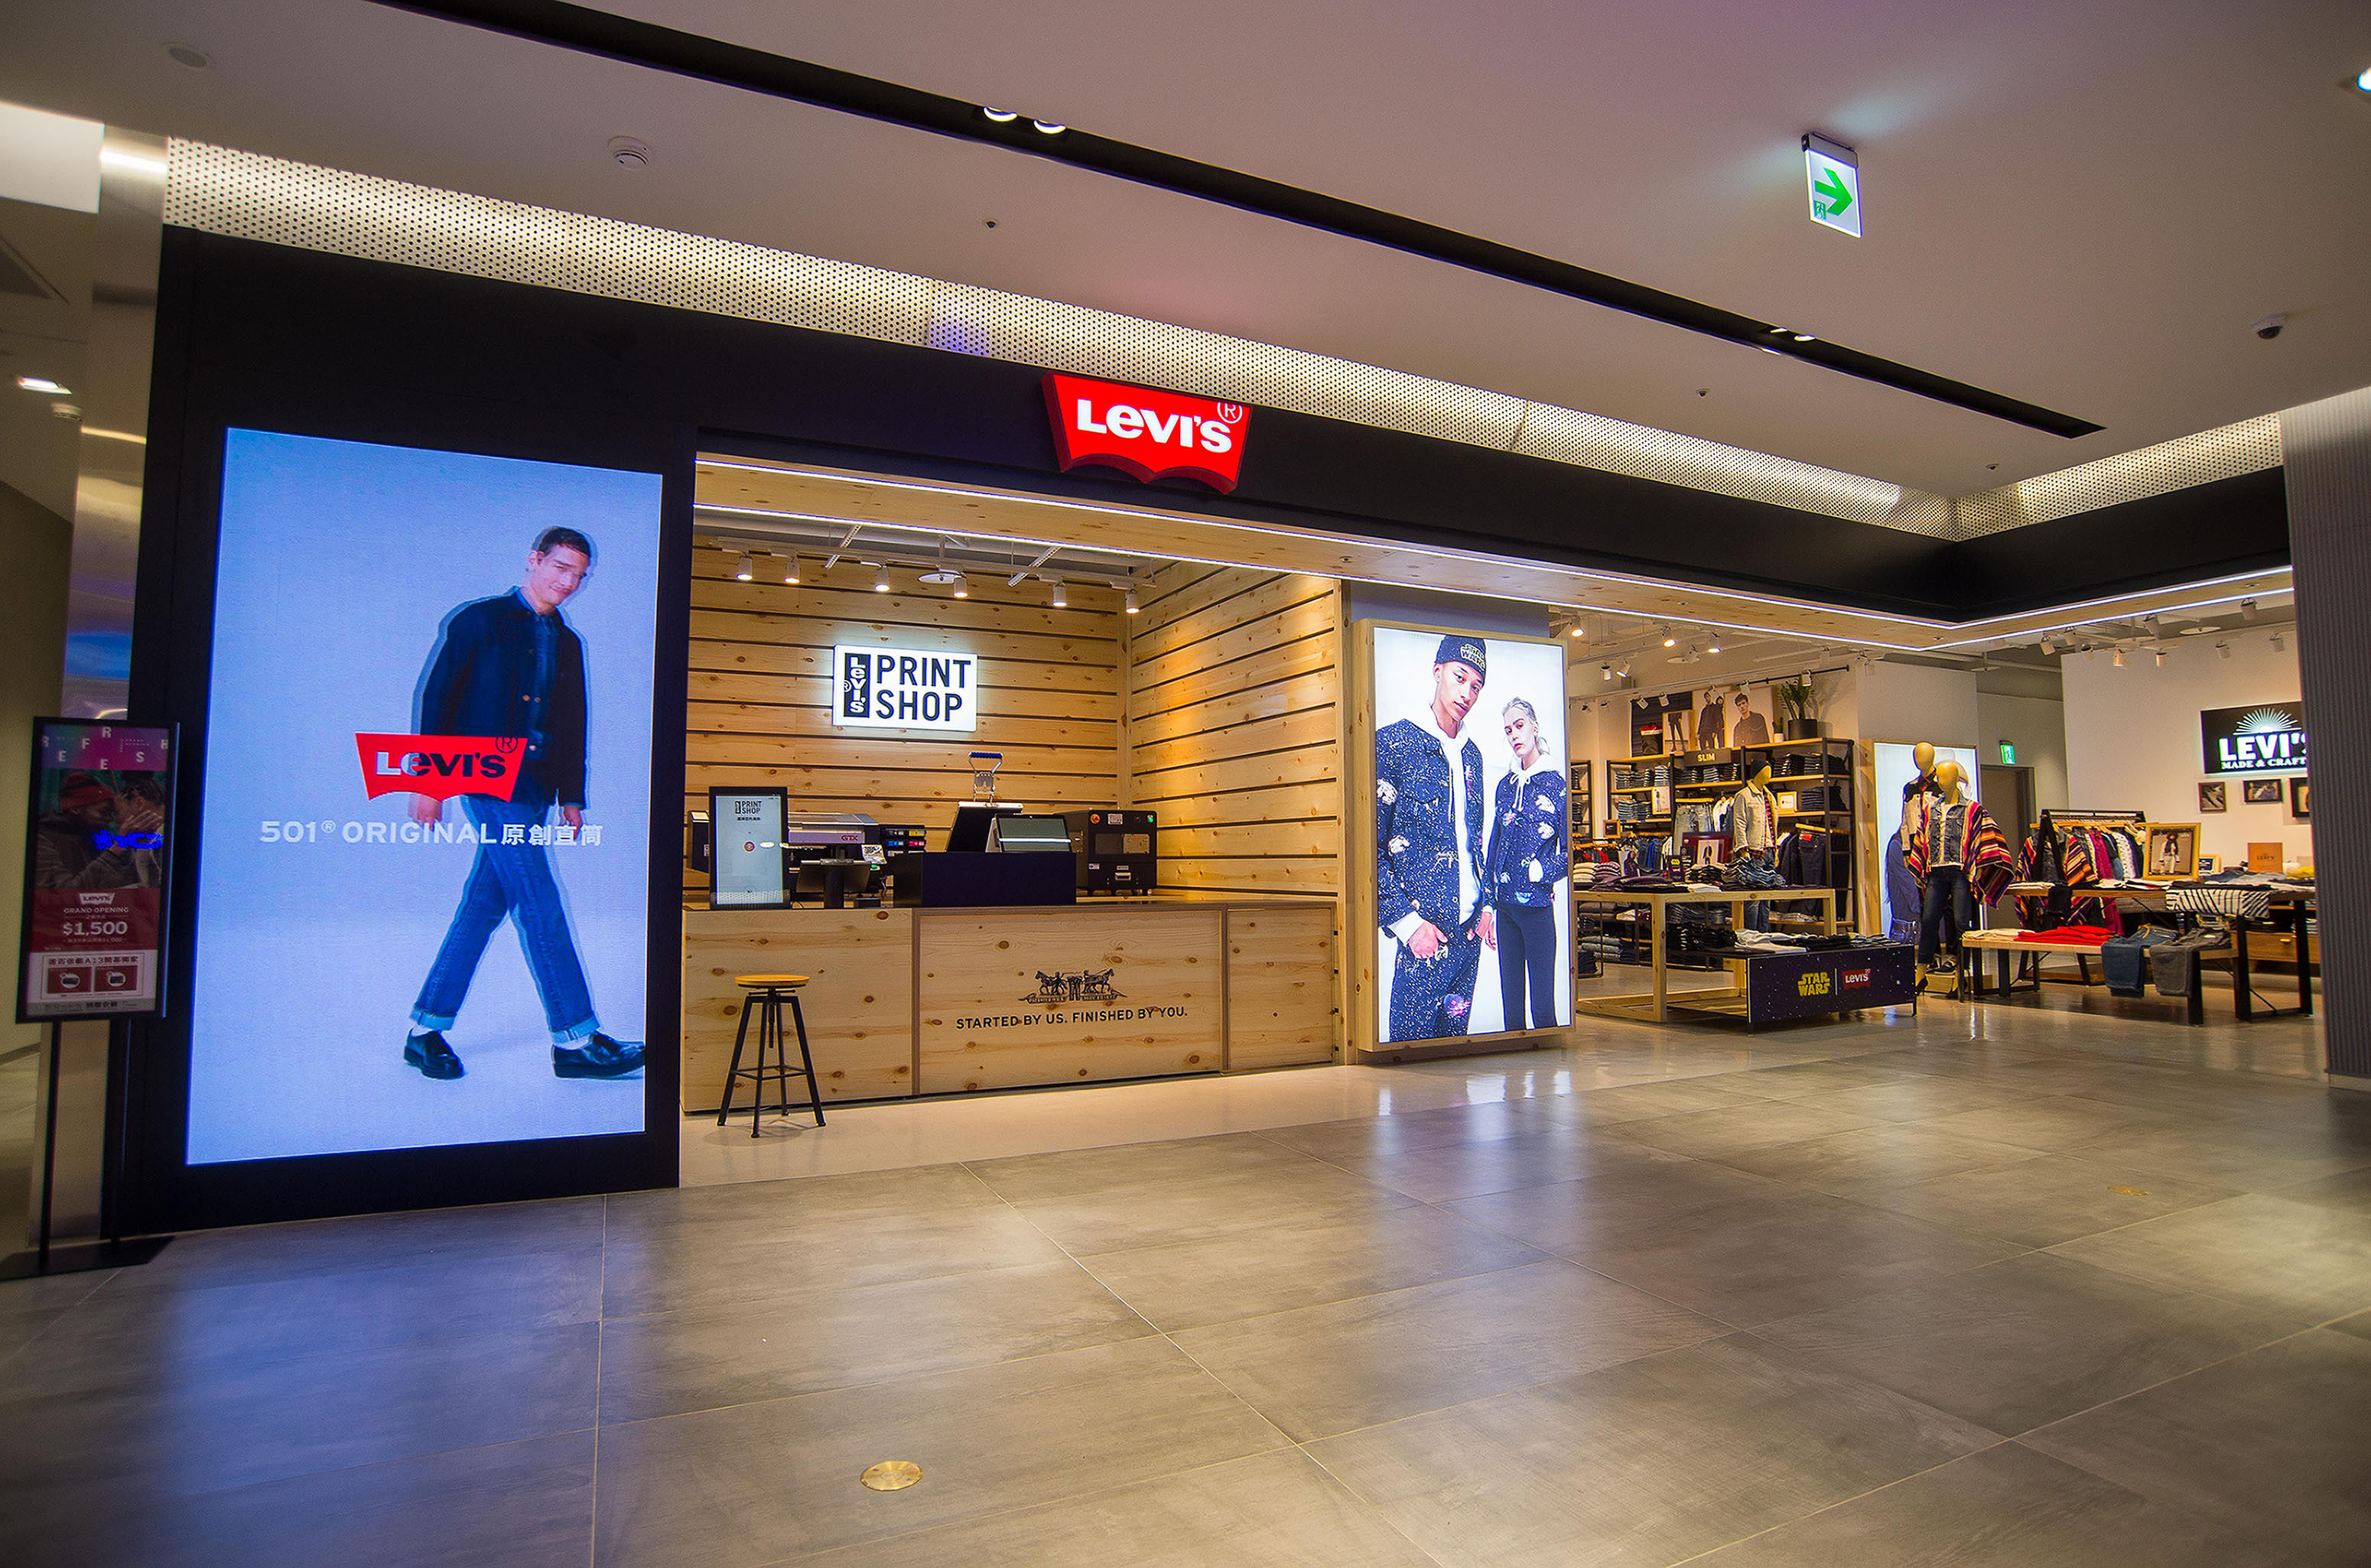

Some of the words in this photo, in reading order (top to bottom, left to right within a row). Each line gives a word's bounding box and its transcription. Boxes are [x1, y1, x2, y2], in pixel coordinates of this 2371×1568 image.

[877, 655, 972, 688] PRINT
[876, 689, 963, 722] SHOP
[1697, 753, 1716, 762] SLIM
[2221, 760, 2253, 769] MADE
[2256, 760, 2265, 768] &
[342, 821, 497, 844] ORIGINAL
[501, 823, 603, 847] 原創直筒
[63, 921, 128, 936] $1,500
[1797, 971, 1830, 985] STAR
[1797, 983, 1830, 997] WARS
[956, 1016, 1020, 1030] STARTED
[1023, 1014, 1042, 1026] BY
[1046, 1013, 1068, 1024] US.
[1072, 1010, 1134, 1023] FINISHED
[1137, 1008, 1155, 1019] BY
[1158, 1006, 1188, 1017] YOU.
